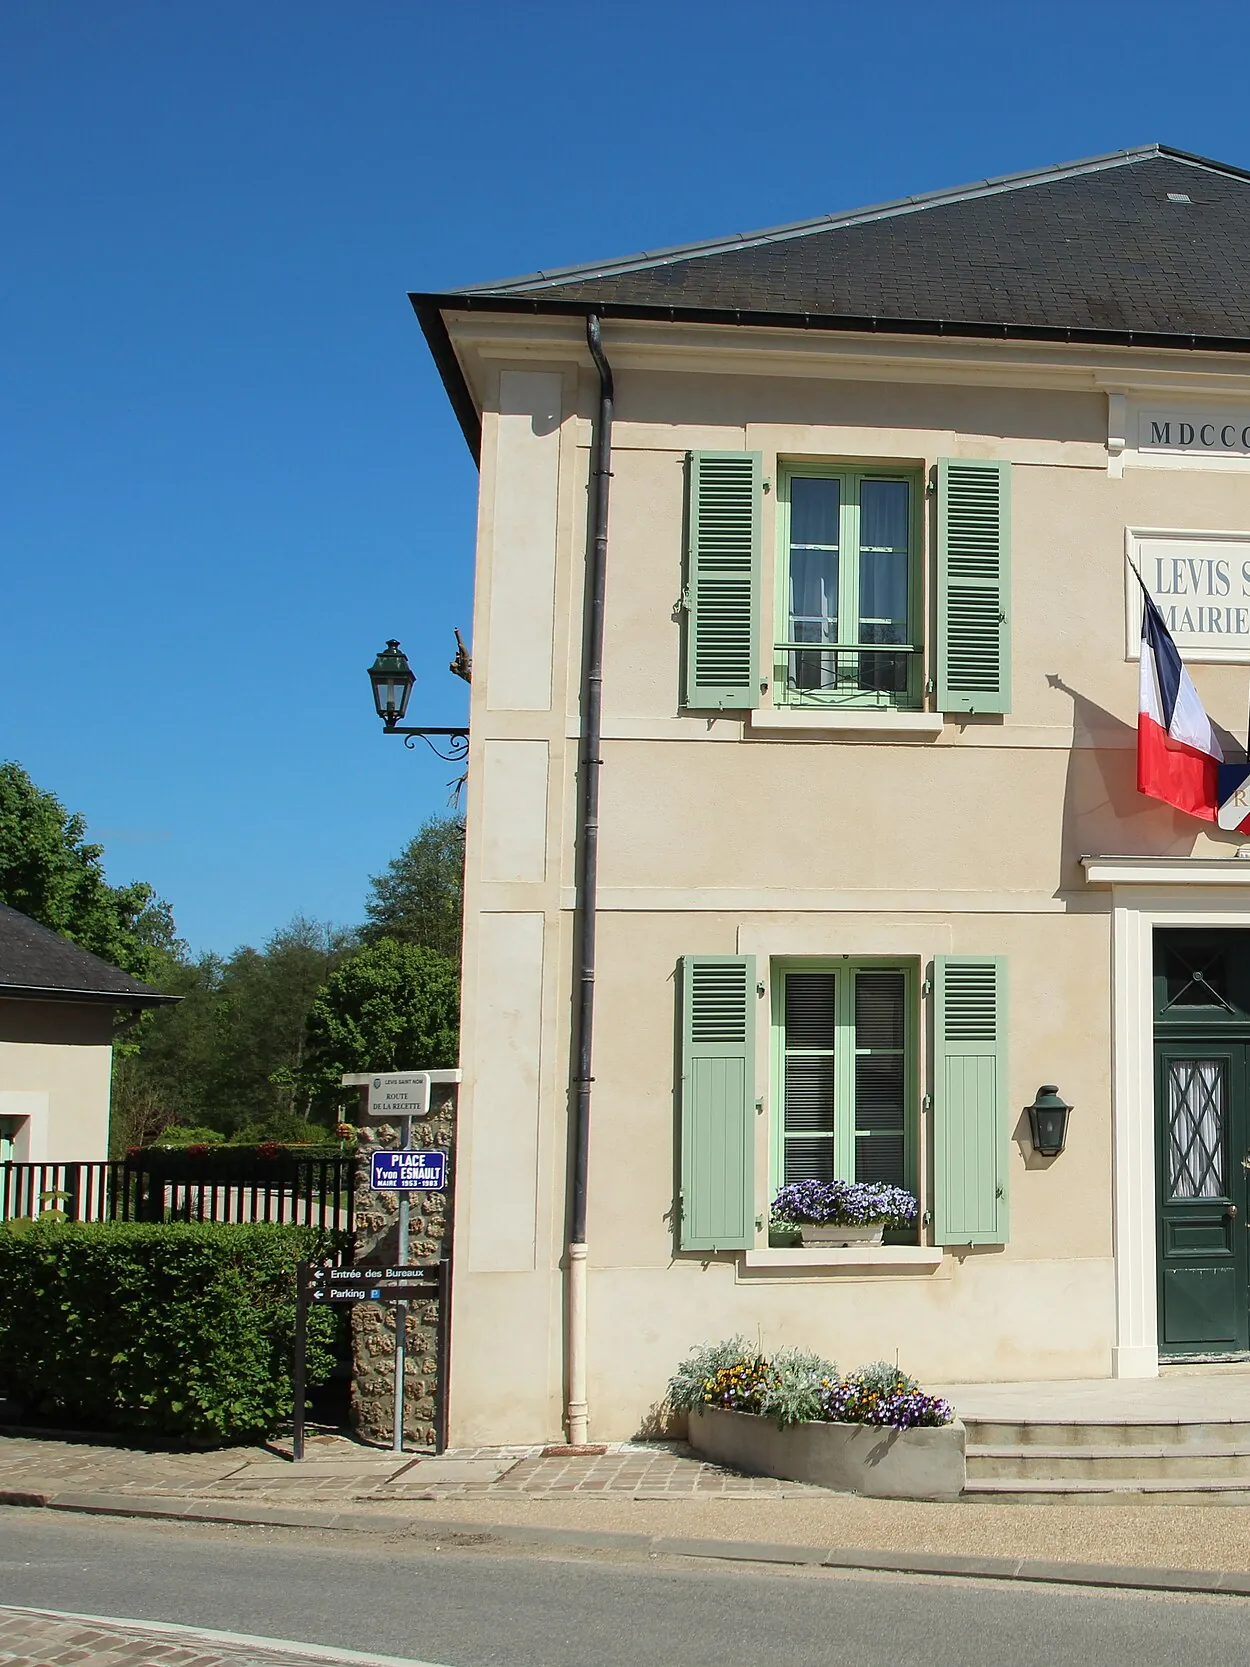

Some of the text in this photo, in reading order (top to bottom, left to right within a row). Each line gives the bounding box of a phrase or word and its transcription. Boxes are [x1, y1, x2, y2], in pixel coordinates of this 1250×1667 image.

[1155, 557, 1231, 597] LEVIS
[392, 1102, 421, 1110] RECETTE
[391, 1154, 426, 1167] PLACE
[376, 1167, 441, 1180] Yvon ESNAULT
[330, 1268, 424, 1279] Entrée des Bureaux
[330, 1289, 365, 1299] Parking
